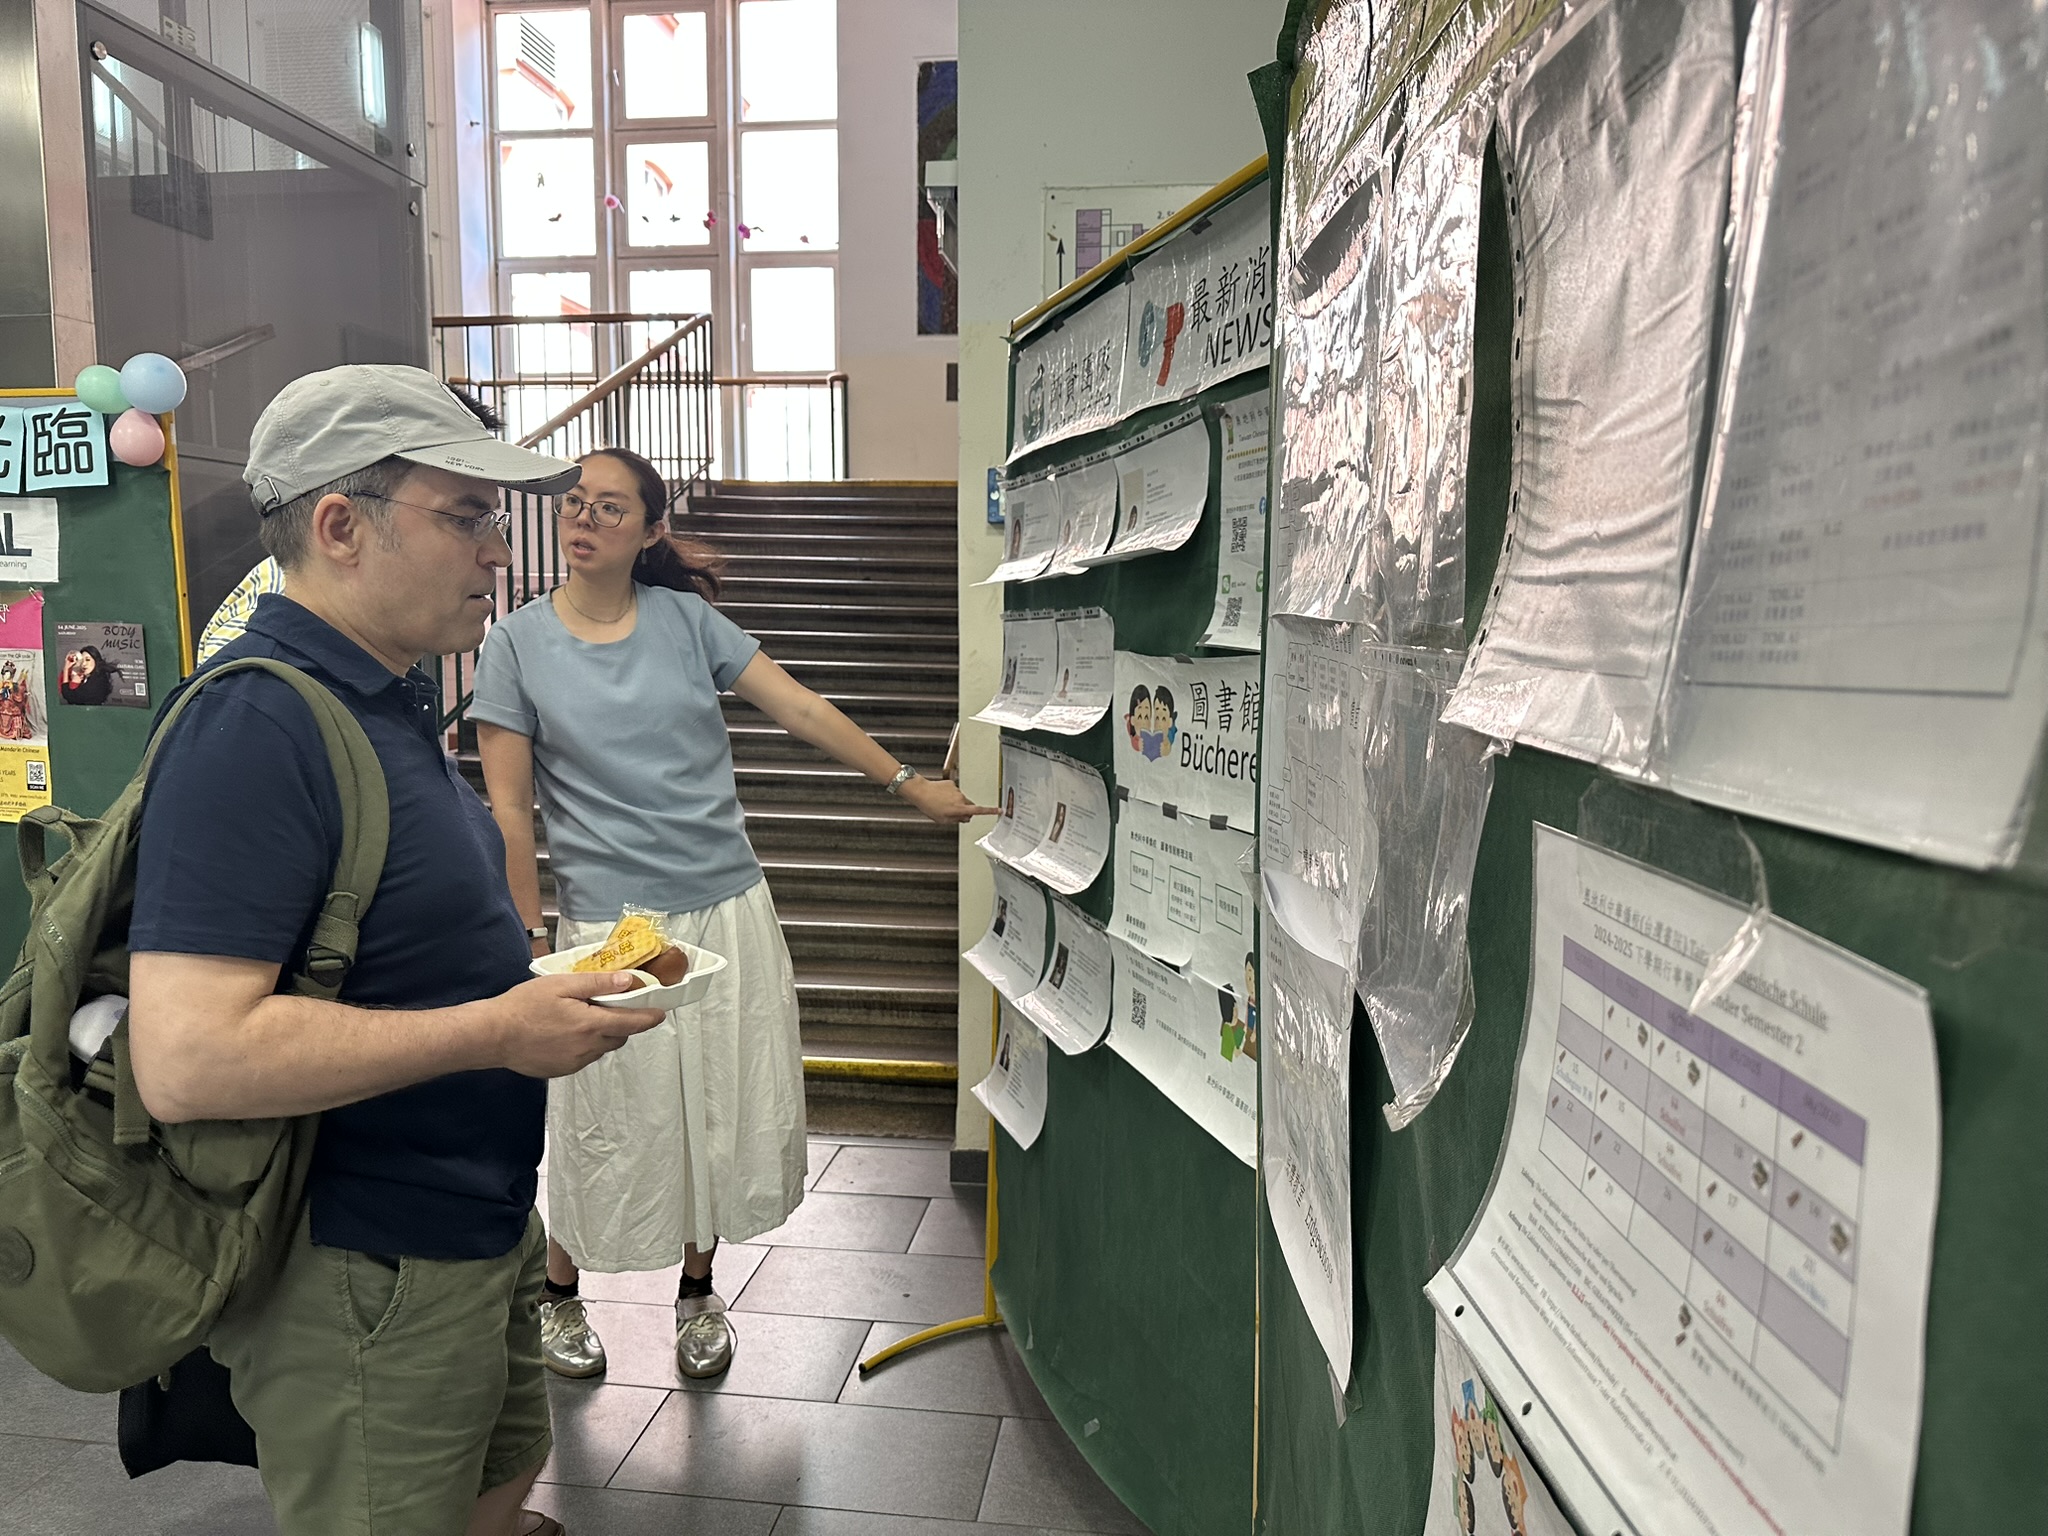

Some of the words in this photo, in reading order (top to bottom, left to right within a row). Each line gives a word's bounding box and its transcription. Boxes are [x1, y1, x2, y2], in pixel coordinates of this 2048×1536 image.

[1204, 302, 1271, 369] NEWS
[101, 639, 141, 650] MUSIC
[102, 625, 136, 638] BODY
[1190, 679, 1260, 735] 圖書館
[1181, 732, 1257, 783] Büchere
[1593, 924, 1632, 958] 2024-2025
